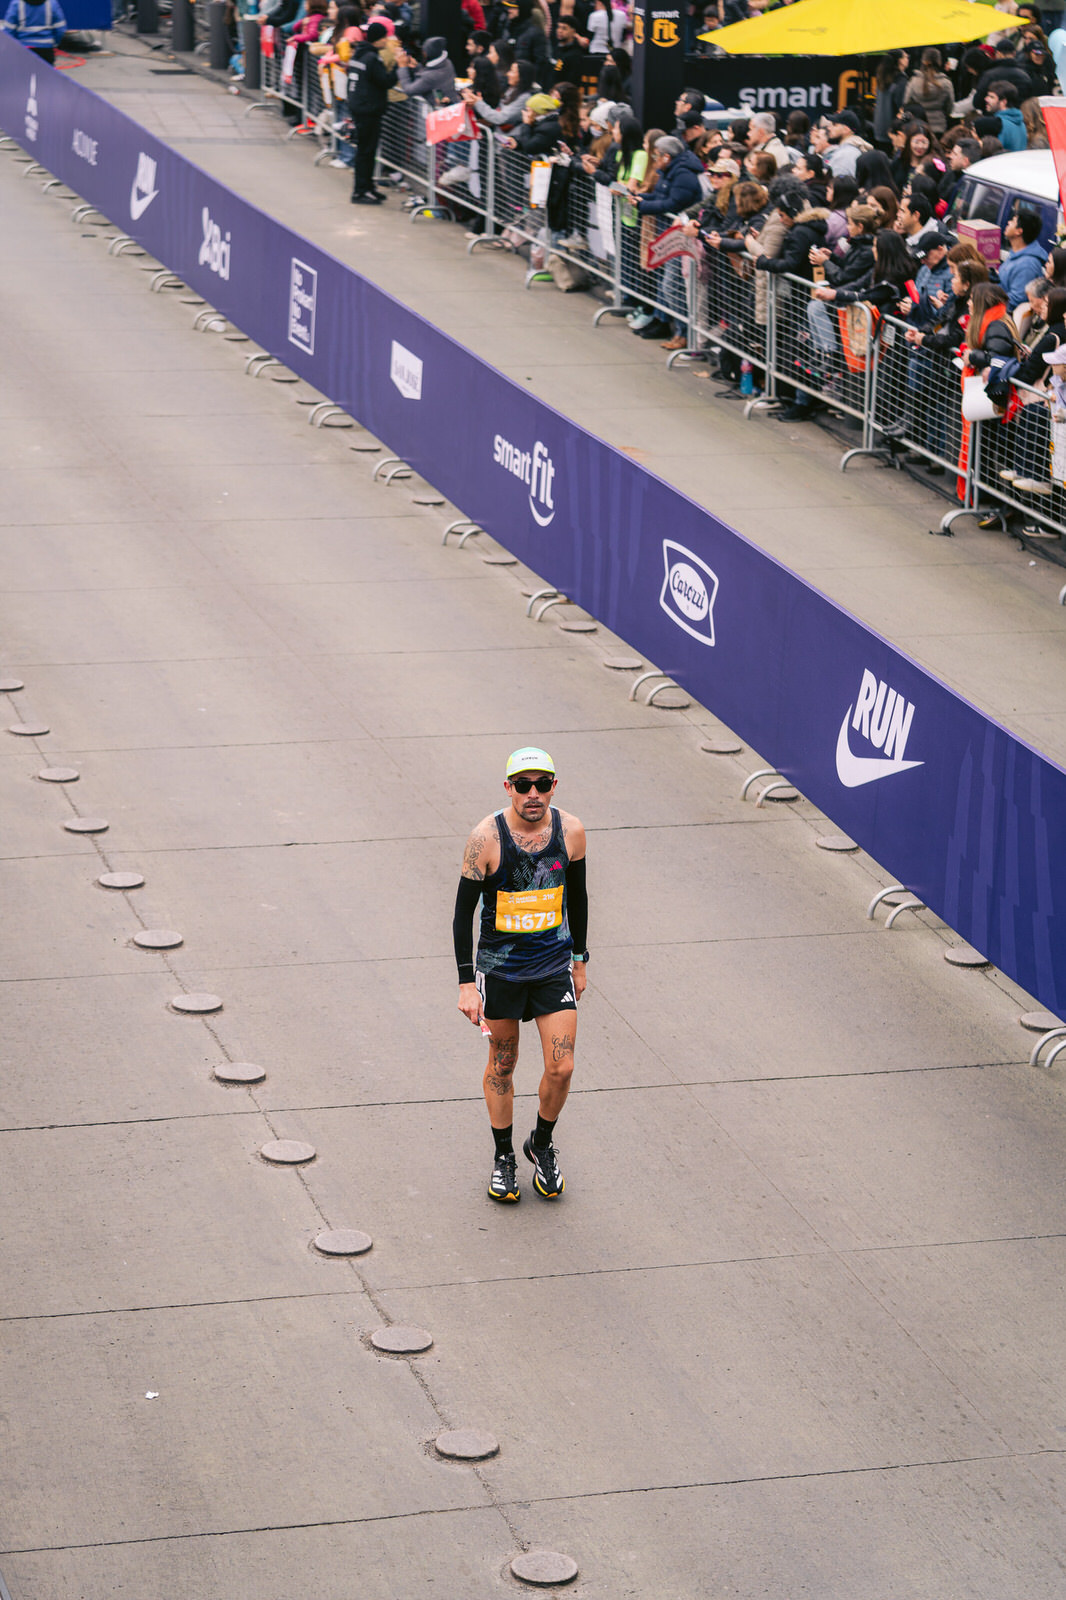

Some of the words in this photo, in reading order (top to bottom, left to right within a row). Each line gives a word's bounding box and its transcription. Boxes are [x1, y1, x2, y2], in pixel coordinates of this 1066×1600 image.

[651, 10, 680, 18] smart
[653, 19, 678, 40] fit
[738, 83, 833, 108] smart
[493, 434, 531, 485] smart
[530, 440, 555, 510] fit
[851, 667, 916, 761] RUN
[542, 893, 555, 901] 21K
[503, 911, 556, 930] 11679
